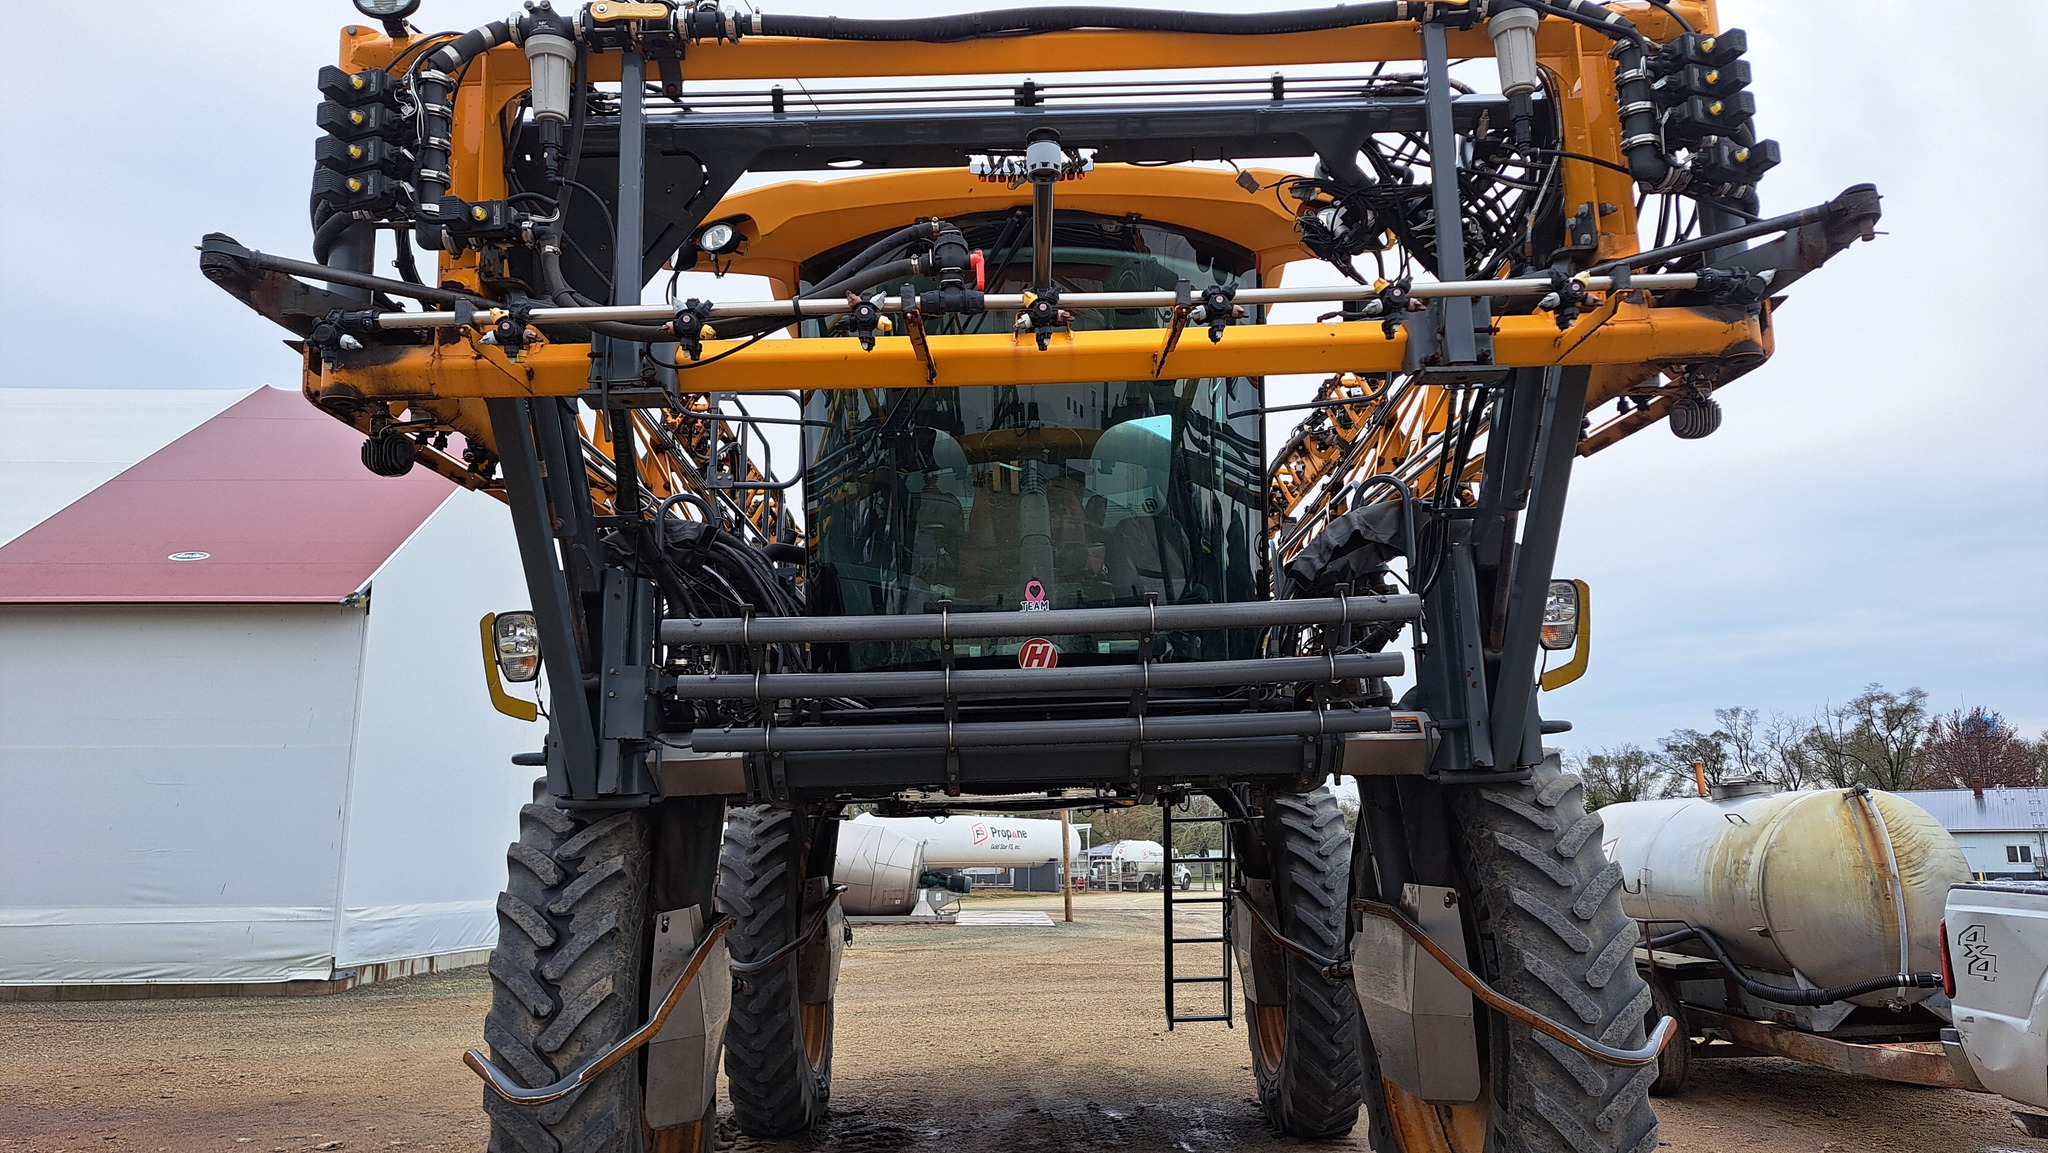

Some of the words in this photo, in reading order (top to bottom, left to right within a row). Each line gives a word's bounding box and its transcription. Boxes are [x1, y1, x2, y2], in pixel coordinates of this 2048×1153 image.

[1021, 601, 1049, 611] TEAM
[1023, 644, 1053, 669] H
[990, 826, 1027, 840] Propane
